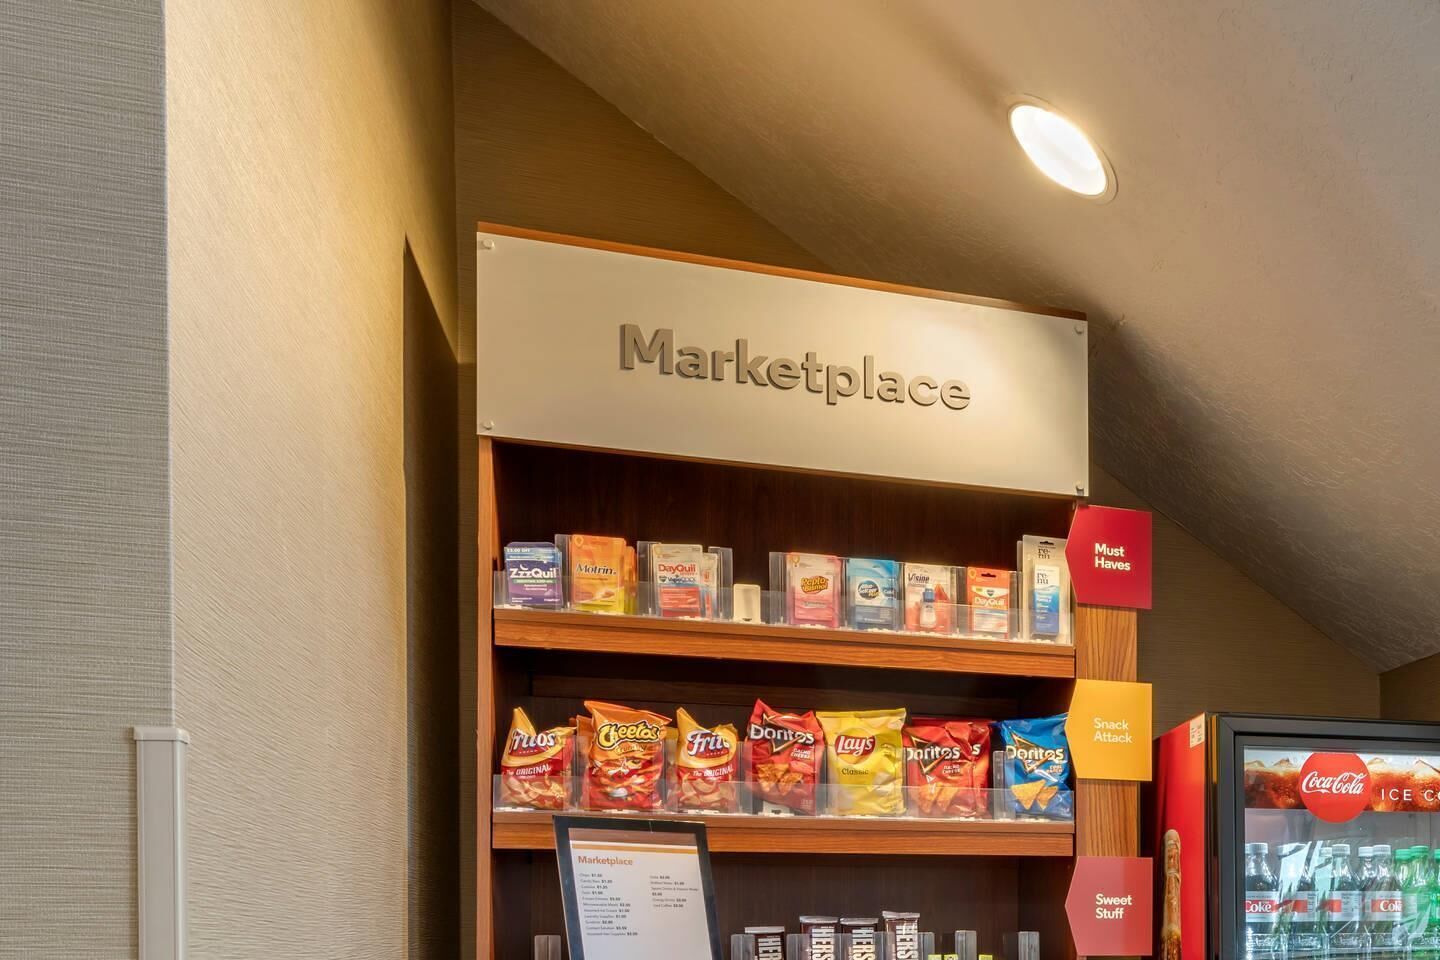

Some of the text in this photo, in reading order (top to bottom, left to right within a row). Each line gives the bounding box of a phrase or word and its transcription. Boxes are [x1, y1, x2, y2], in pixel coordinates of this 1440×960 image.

[619, 323, 971, 411] Marketplace
[1095, 542, 1125, 557] Must
[576, 563, 614, 576] Motrin
[658, 564, 696, 575] DayQuil
[1095, 556, 1131, 571] Haves
[510, 566, 557, 579] ZzzQuil
[908, 573, 930, 583] Visine
[800, 576, 829, 586] Pepto
[974, 597, 1005, 607] DayQuil
[1094, 718, 1129, 730] Snack
[597, 720, 661, 750] Cheetos
[751, 723, 815, 744] Doritos
[1094, 732, 1133, 743] Attack
[837, 735, 874, 757] Lay's
[1006, 745, 1064, 760] Doritos
[515, 764, 551, 776] ORIGINAL
[841, 768, 869, 776] Classic
[1302, 771, 1368, 795] Coca-Cola
[1381, 788, 1412, 801] ICE
[578, 855, 633, 867] Marketplace
[1095, 893, 1132, 906] Sweet
[1245, 901, 1271, 912] Coke
[1380, 901, 1402, 912] Cok
[1095, 907, 1124, 919] Stuff
